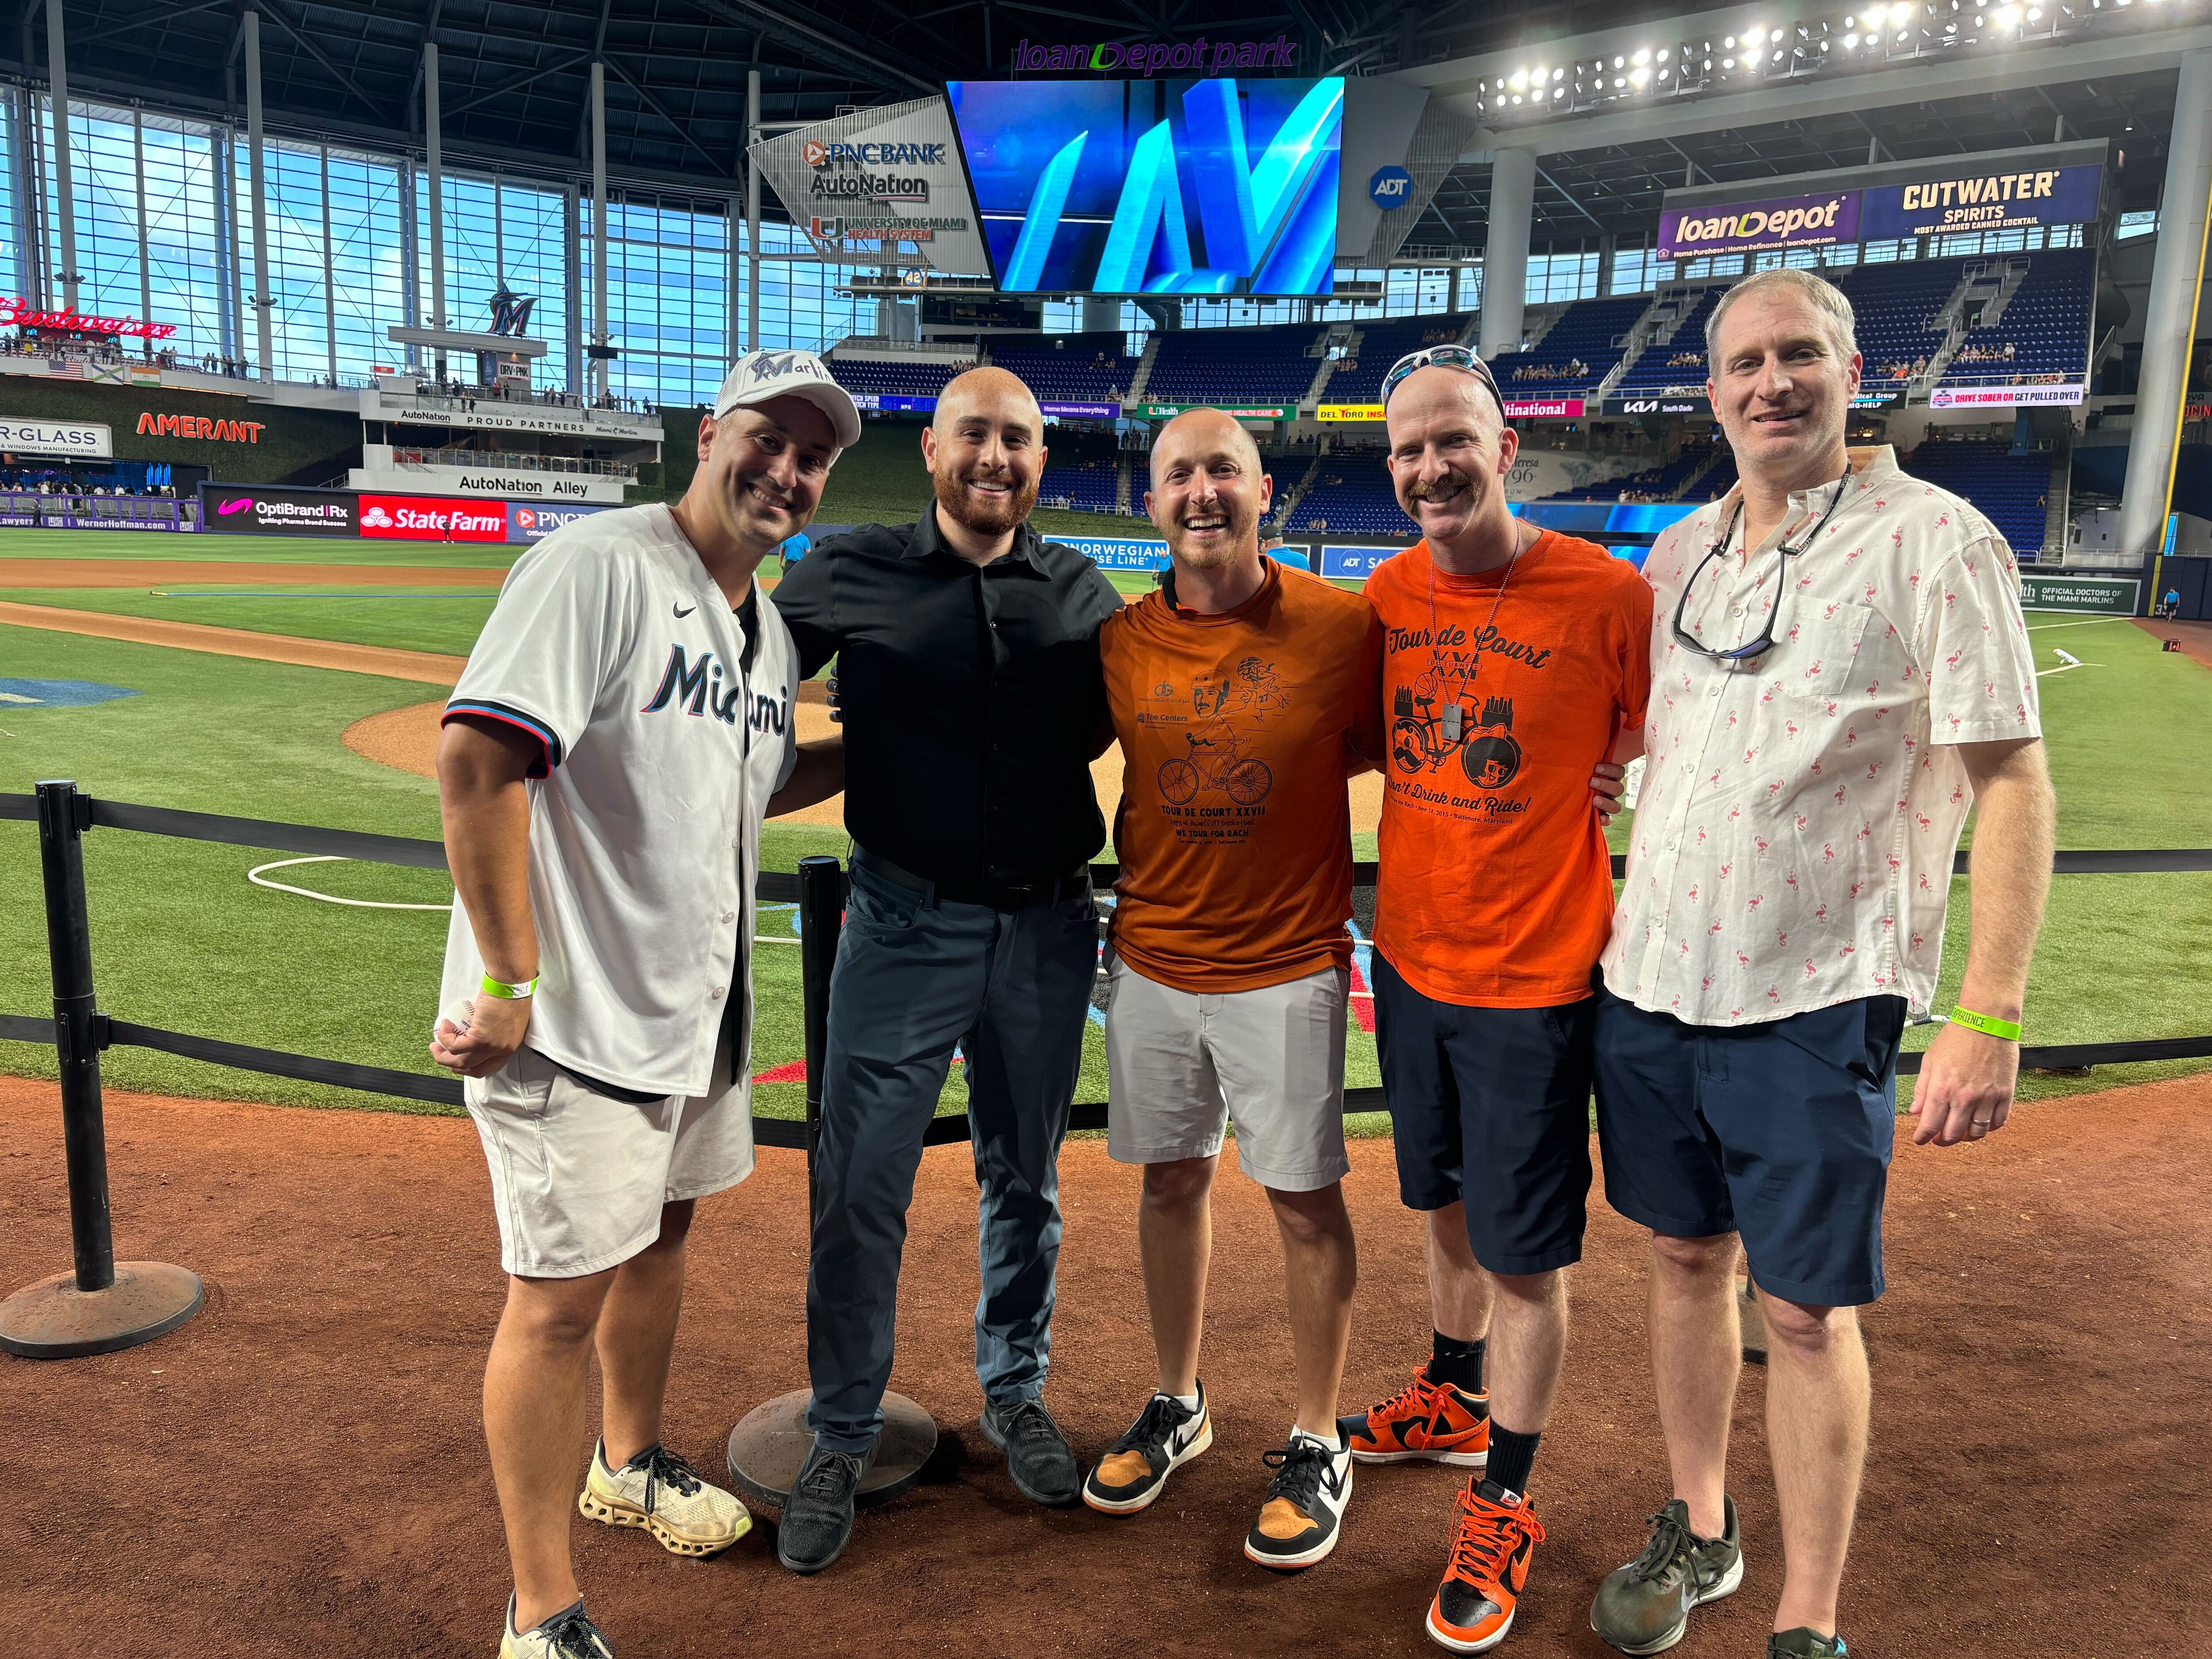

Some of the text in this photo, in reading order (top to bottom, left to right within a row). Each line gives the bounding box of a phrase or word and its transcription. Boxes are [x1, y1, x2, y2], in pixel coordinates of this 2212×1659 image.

[1016, 35, 1297, 77] loanDepot park
[810, 174, 926, 193] AutoNation
[1374, 179, 1408, 195] ADT
[1903, 171, 2053, 210] CUTWATER
[1675, 200, 1840, 243] loanDepot
[1944, 205, 2005, 223] SPIRITS
[847, 217, 965, 229] UNIVERSITY OF MIAMI
[1935, 223, 1970, 233] AWARDED
[1972, 220, 2001, 229] CANNED
[2003, 217, 2039, 227] COCKTAIL
[848, 229, 932, 240] HEALTH SYSTEM
[1694, 247, 1725, 257] Purchase
[1749, 242, 1782, 251] Refinance
[1786, 236, 1836, 247] loanDepot.com
[906, 272, 920, 282] 42
[0, 296, 177, 340] Budweiser
[500, 365, 528, 377] DRV PNK
[1955, 392, 2079, 402] DRIVE SOBER OR GET PULLED OVER
[402, 411, 450, 422] AutoNation
[468, 417, 512, 426] PROUD
[521, 420, 584, 431] PARTNERS
[1341, 409, 1363, 418] TORO
[136, 412, 262, 444] AMERANT
[460, 476, 588, 498] AutoNation Alley
[77, 518, 165, 530] WernerHoffman.com
[259, 517, 282, 526] Igniting
[395, 508, 499, 532] State Farm
[1118, 557, 1145, 565] LINE
[1343, 558, 1361, 567] ADT
[1389, 624, 1551, 669] Tour de Court
[640, 644, 787, 736] Miami
[1259, 694, 1269, 703] 27
[1411, 783, 1448, 805] Drink
[1451, 796, 1481, 810] and
[1485, 797, 1532, 817] Ride!
[1161, 805, 1265, 817] TOUR DE COURT XXVII
[1454, 813, 1482, 823] Baltimore,
[1508, 1493, 1518, 1503] NIKE
